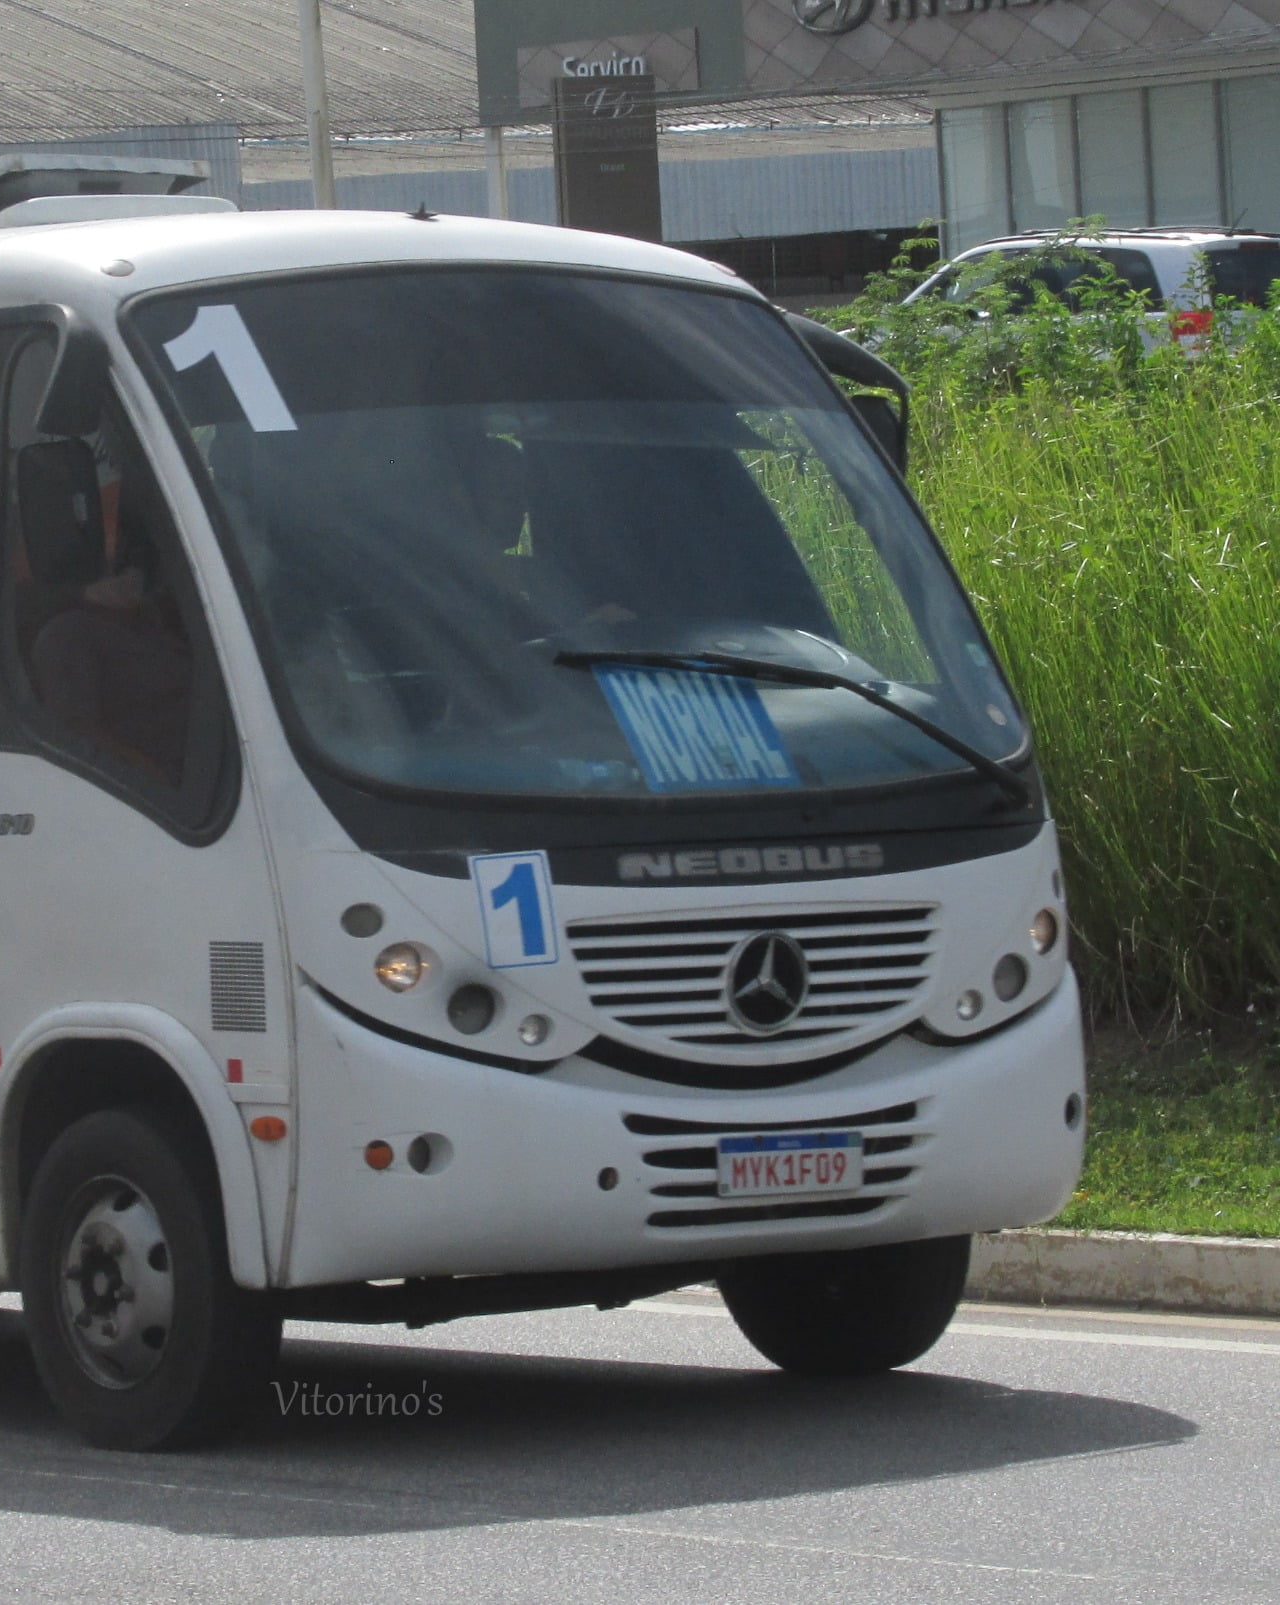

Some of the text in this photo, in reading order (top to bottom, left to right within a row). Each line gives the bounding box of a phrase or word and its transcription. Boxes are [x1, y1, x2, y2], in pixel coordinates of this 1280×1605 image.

[163, 304, 298, 432] 1
[606, 670, 792, 783] NORMAL
[618, 844, 884, 879] NEOBUS
[491, 863, 547, 956] 1
[731, 1151, 846, 1188] MYK1F09
